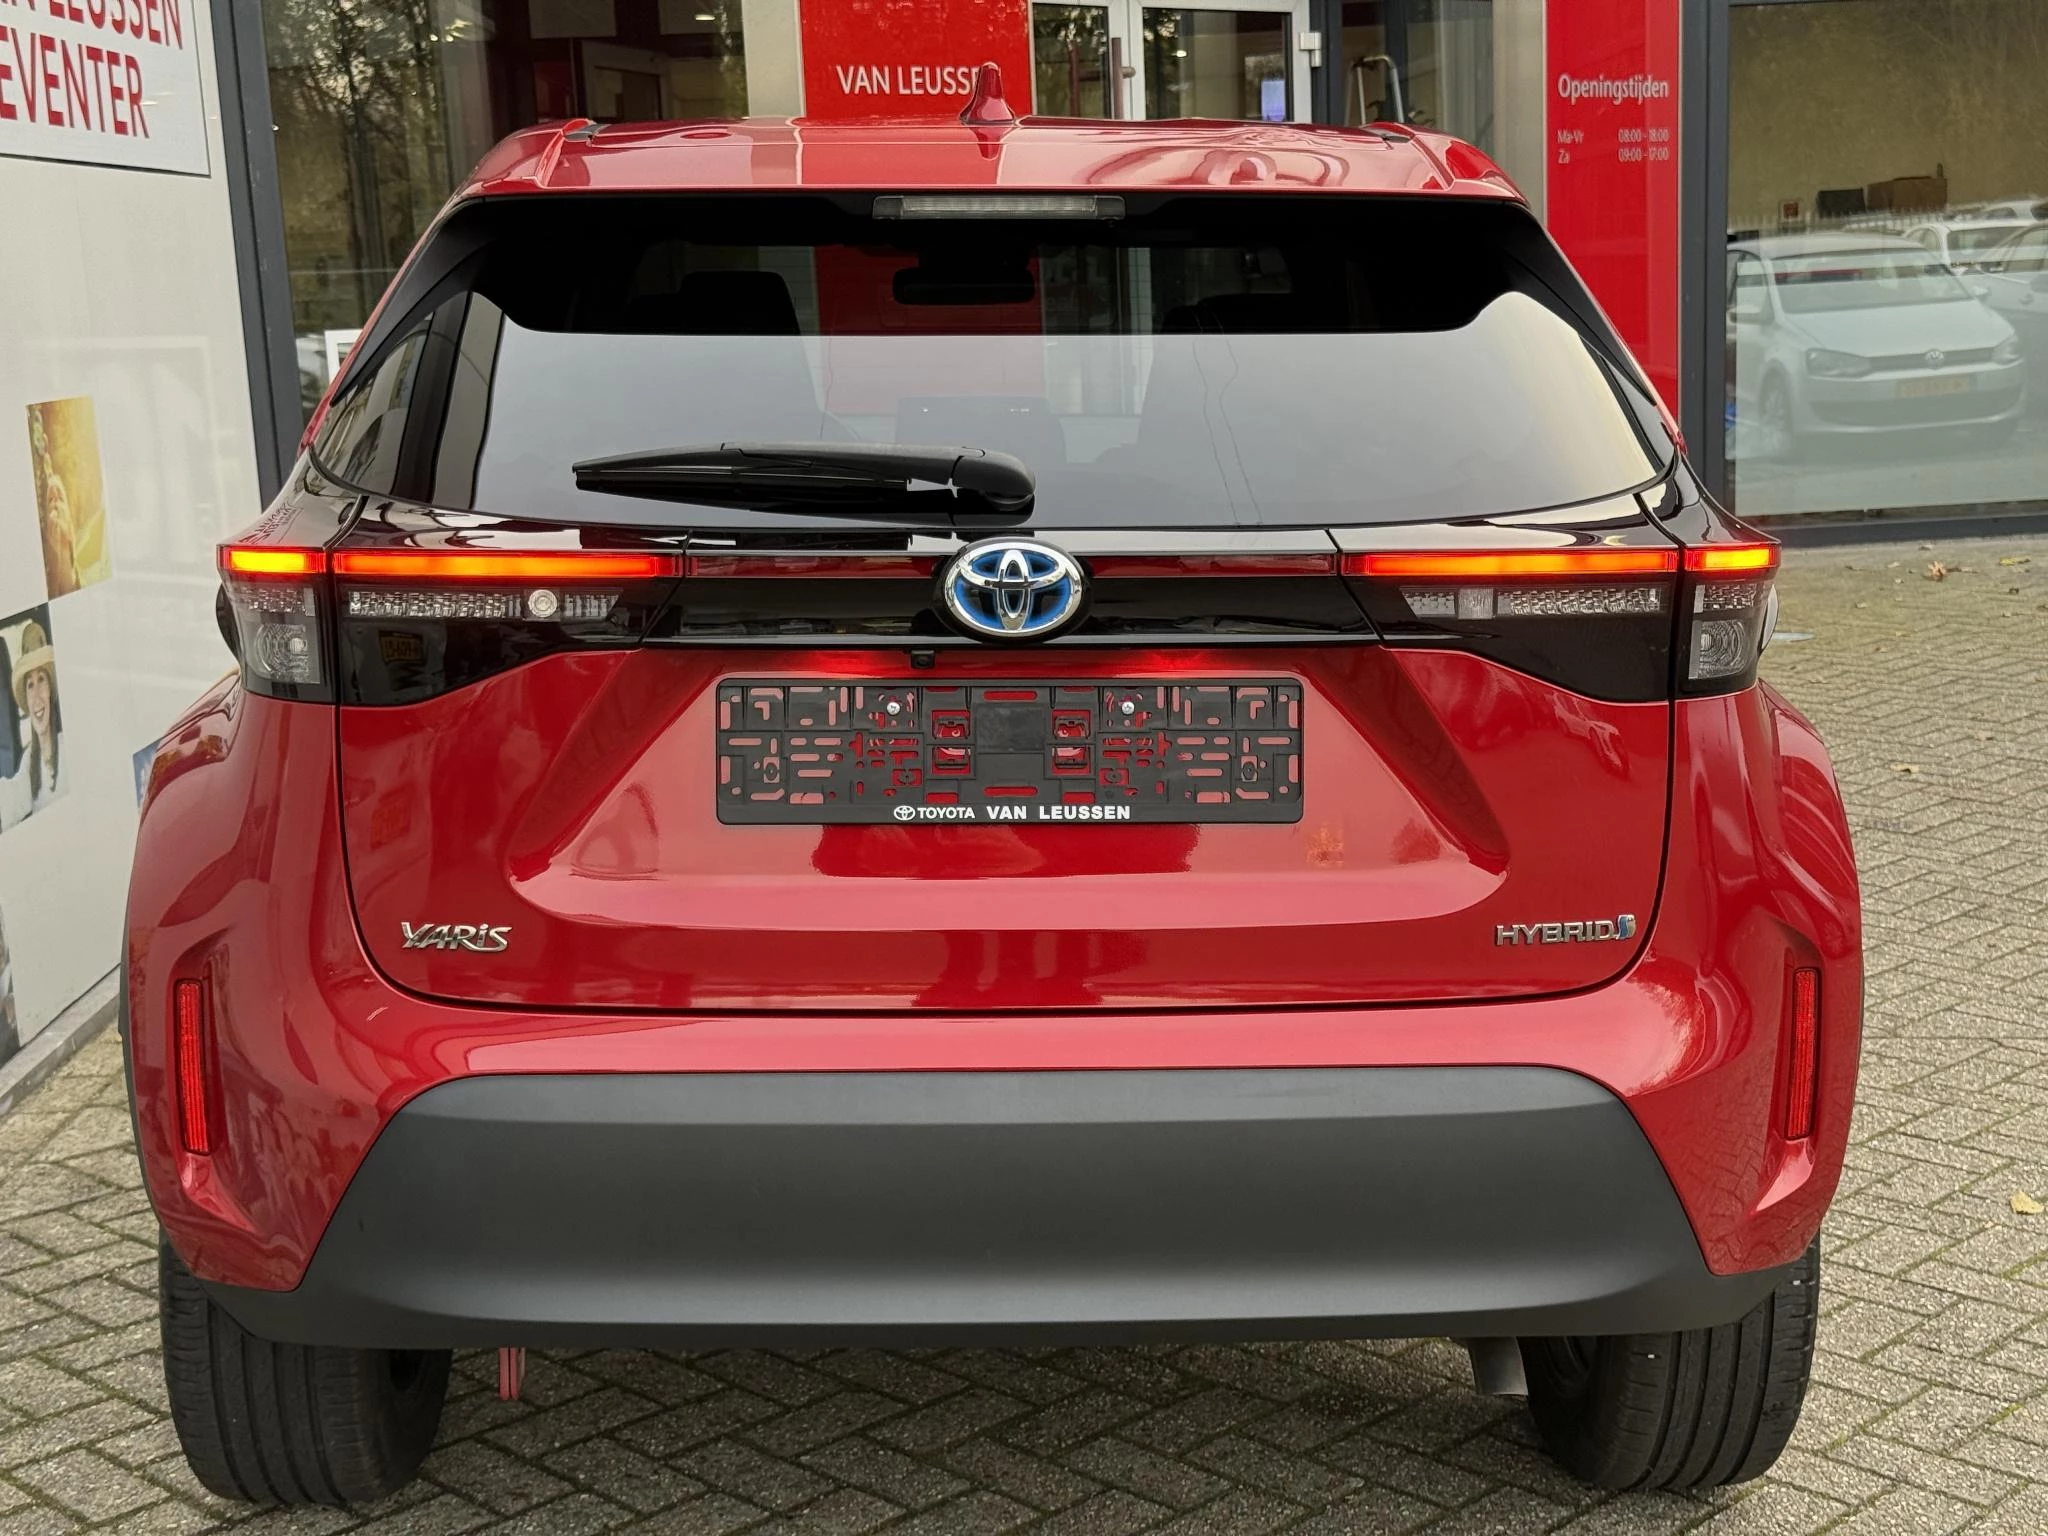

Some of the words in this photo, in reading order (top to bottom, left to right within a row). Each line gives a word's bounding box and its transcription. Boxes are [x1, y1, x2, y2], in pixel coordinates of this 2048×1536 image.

[836, 64, 890, 95] VAN
[897, 65, 1002, 95] LEUSS
[1557, 73, 1669, 105] Openingstijden
[1558, 148, 1570, 164] Za
[917, 807, 976, 819] TOYOTA
[986, 805, 1028, 820] VAN
[1039, 805, 1131, 820] LEUSSEN
[1496, 920, 1616, 946] HYBRID
